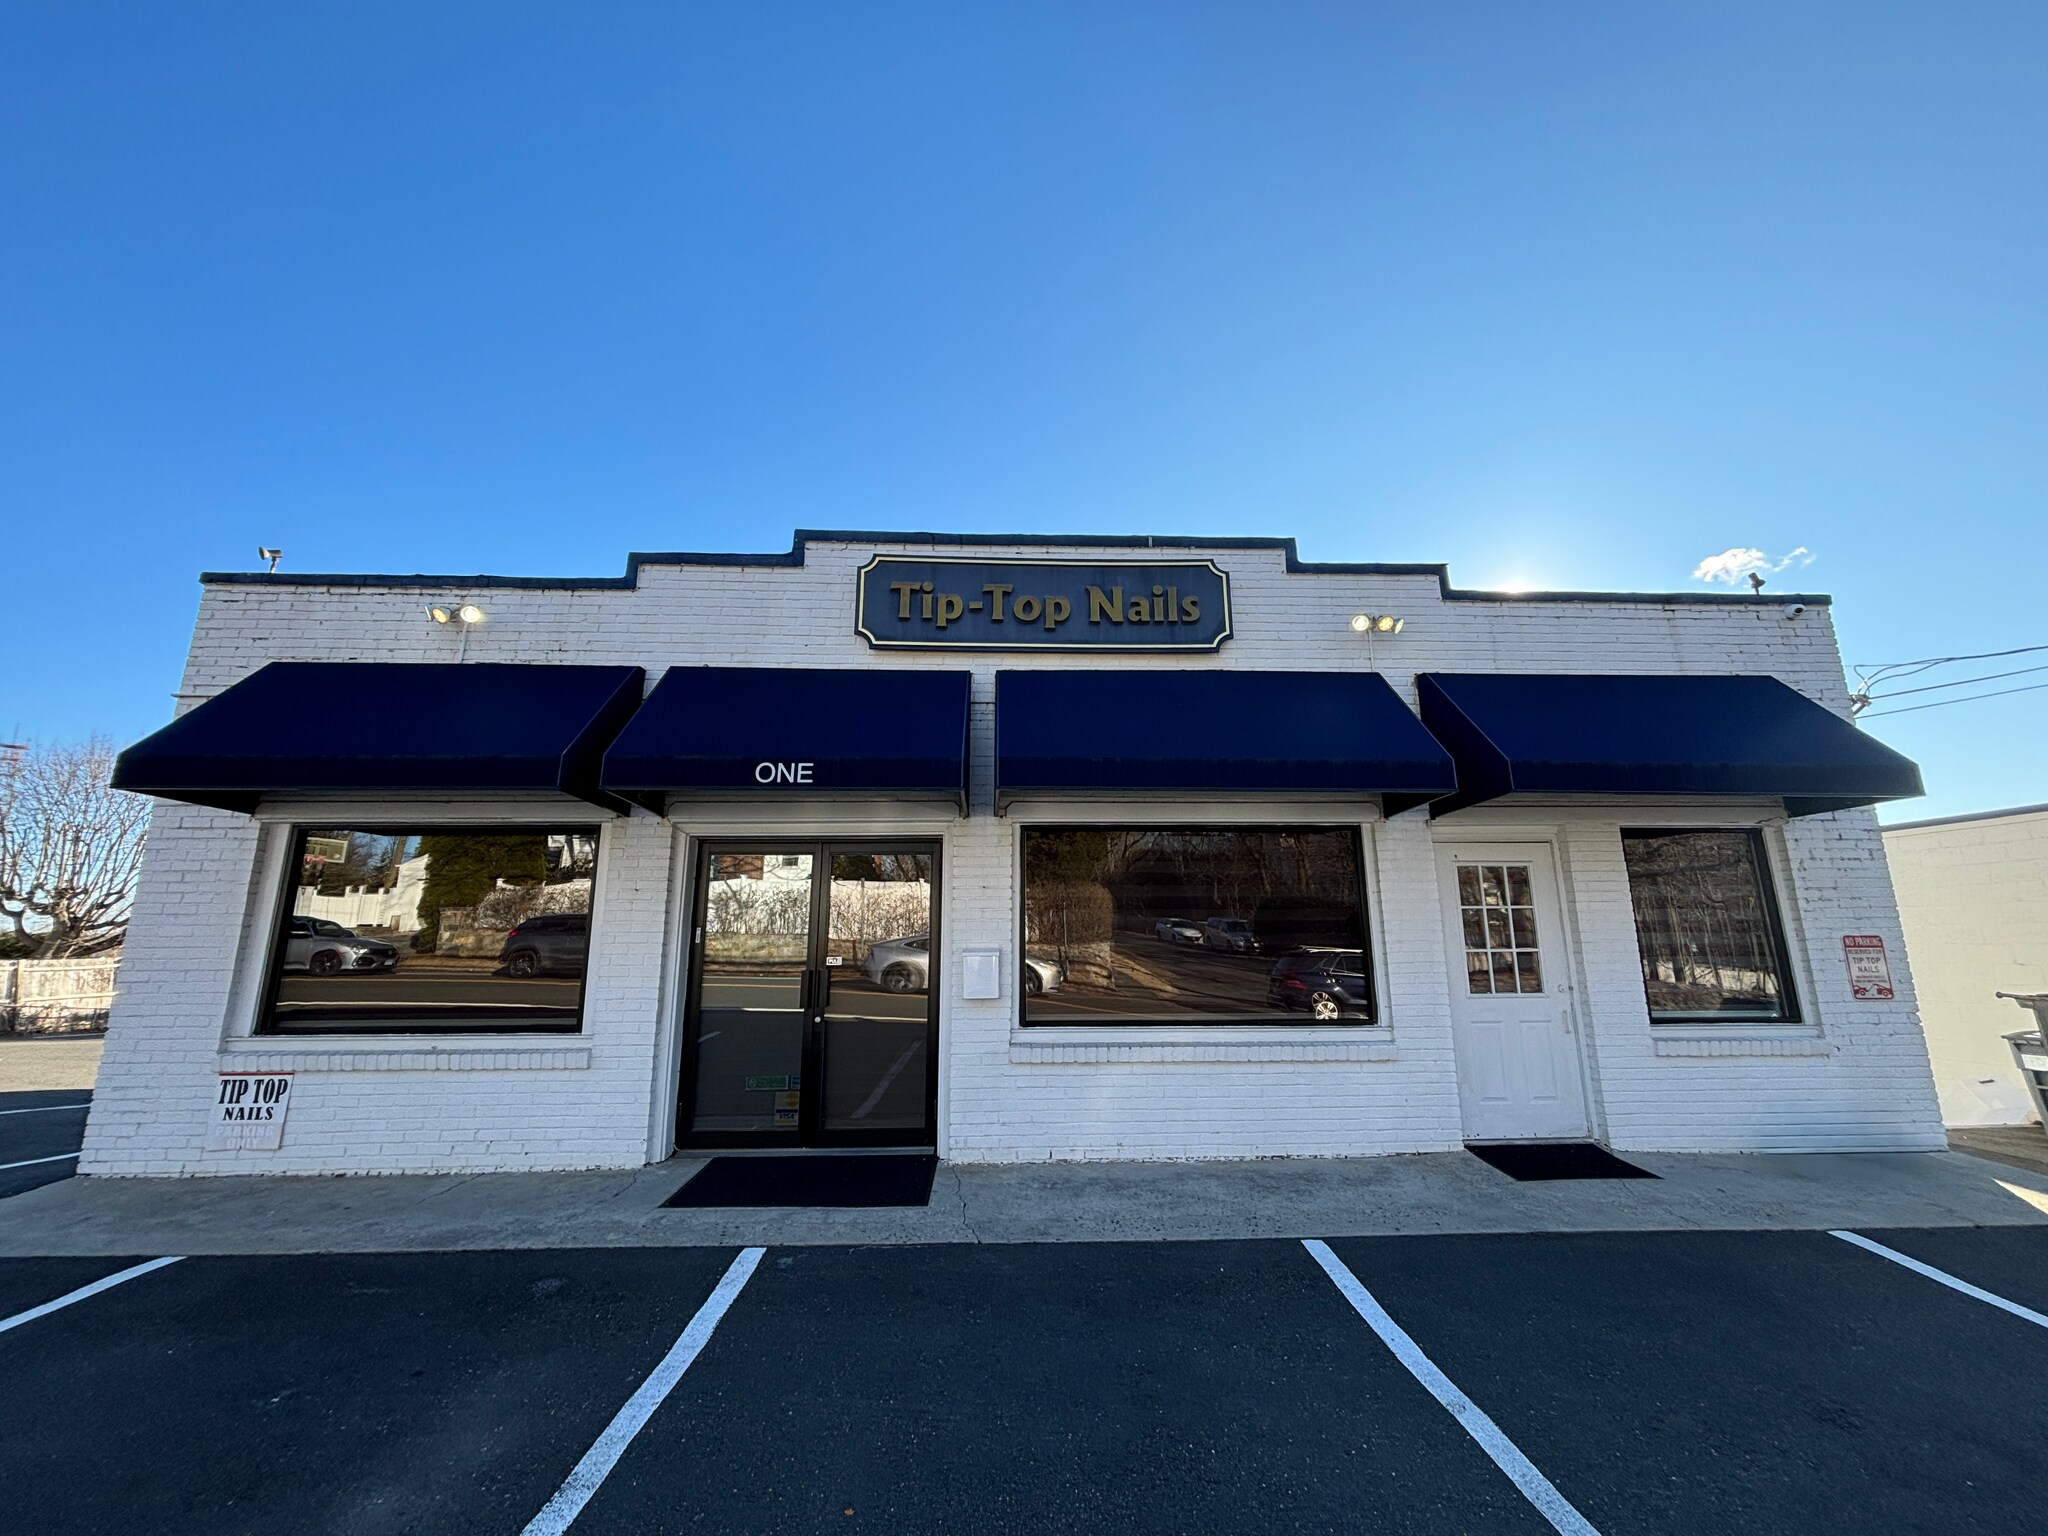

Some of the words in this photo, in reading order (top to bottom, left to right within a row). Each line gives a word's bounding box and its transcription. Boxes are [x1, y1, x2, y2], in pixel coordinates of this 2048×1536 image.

[890, 581, 1071, 628] Tip-Top
[1086, 585, 1201, 622] Nails
[755, 762, 814, 783] ONE
[1845, 937, 1854, 946] NO
[1855, 937, 1882, 946] PARKING
[218, 1079, 249, 1104] TIP
[252, 1078, 288, 1104] TOP
[222, 1106, 274, 1120] NAILS
